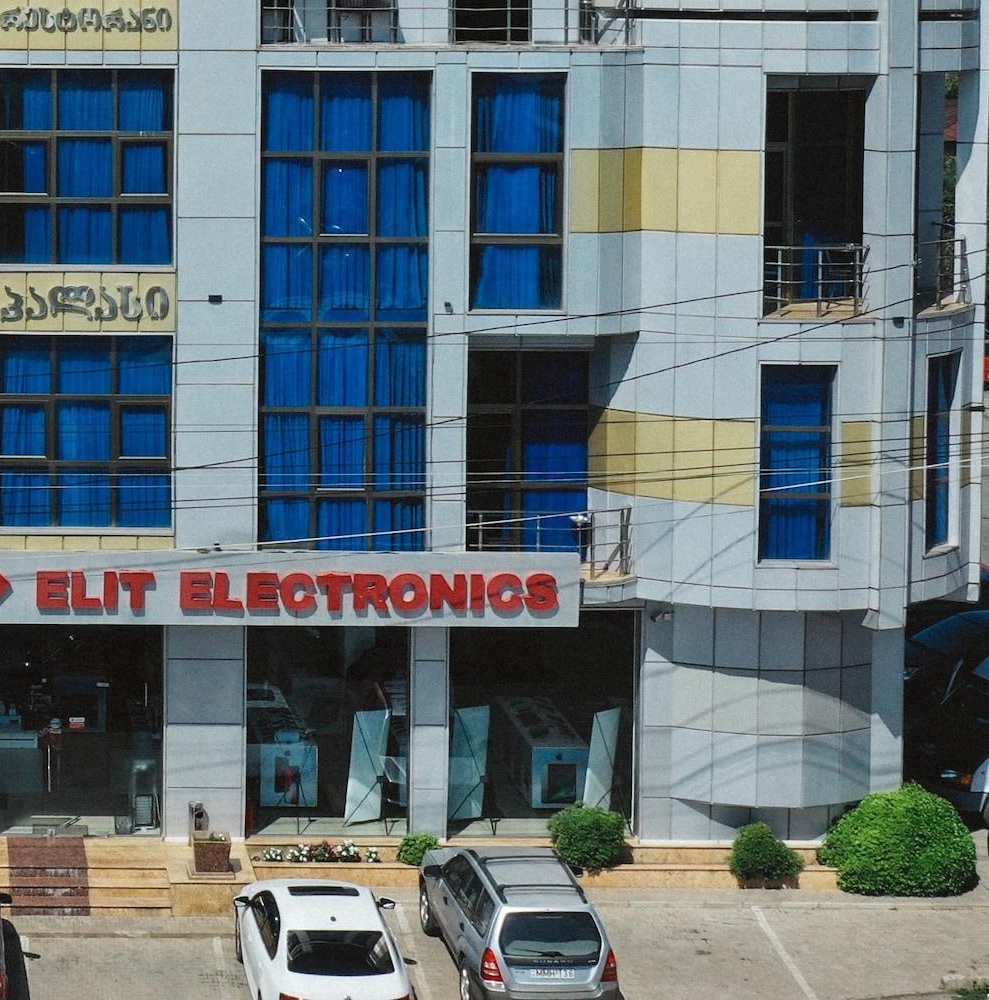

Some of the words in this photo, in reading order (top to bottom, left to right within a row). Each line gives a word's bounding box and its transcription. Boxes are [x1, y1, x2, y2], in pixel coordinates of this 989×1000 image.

[0, 5, 173, 34] რესტორანი
[0, 284, 171, 323] პალასი
[36, 570, 156, 614] ELIT
[179, 571, 559, 616] ELECTRONICS
